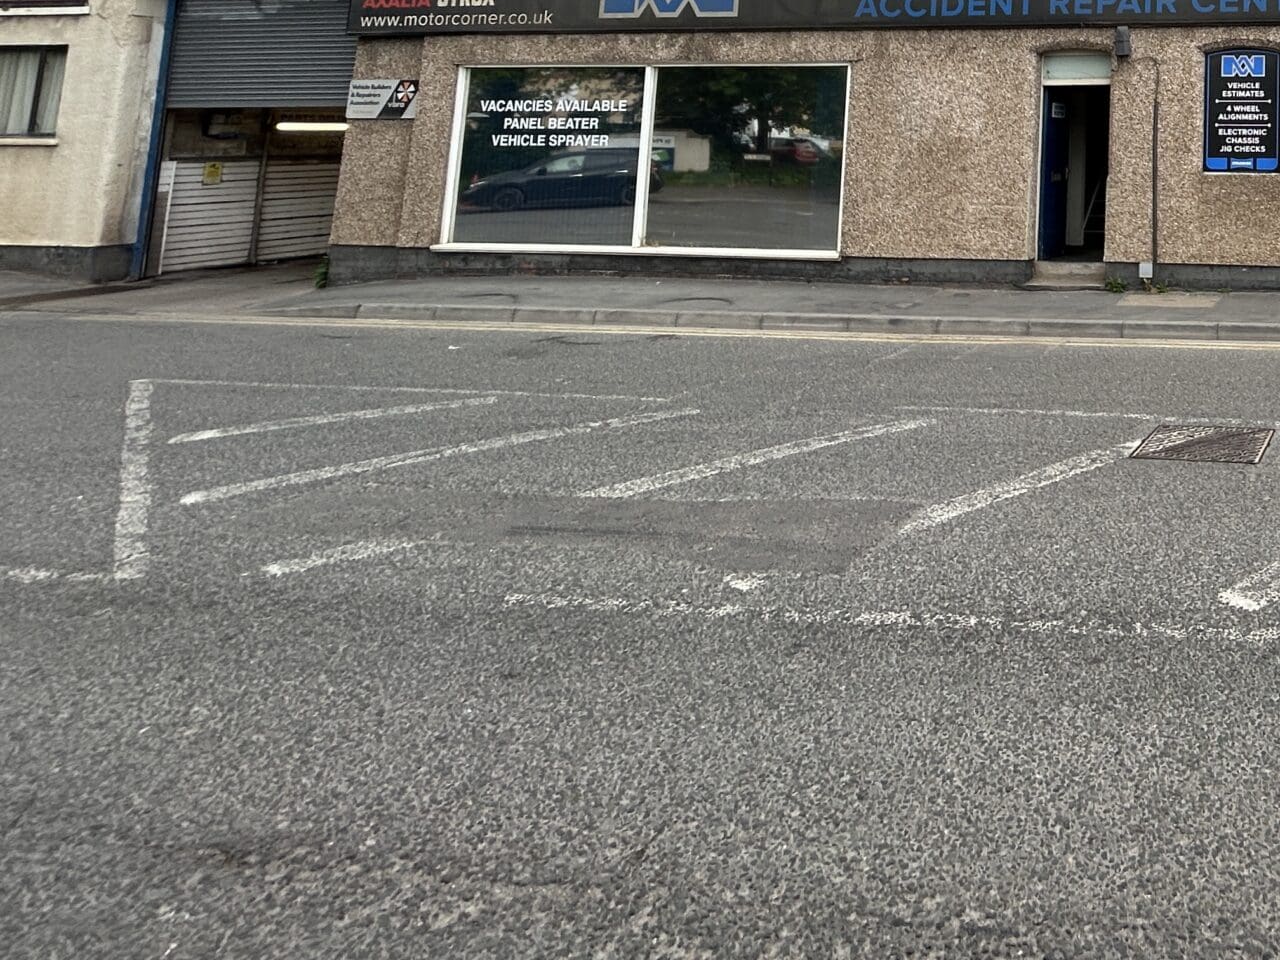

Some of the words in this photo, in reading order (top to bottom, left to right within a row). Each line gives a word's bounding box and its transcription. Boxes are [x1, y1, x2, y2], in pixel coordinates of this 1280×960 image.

[361, 10, 553, 27] www.motorcorner.co.uk
[1222, 90, 1264, 98] ESTIMATES
[480, 100, 552, 112] VACANCIES
[555, 100, 628, 112] AVAILABLE
[503, 118, 545, 130] PANEL
[548, 118, 599, 130] BEATER
[491, 135, 546, 146] VEHICLE
[549, 135, 609, 146] SPRAYER
